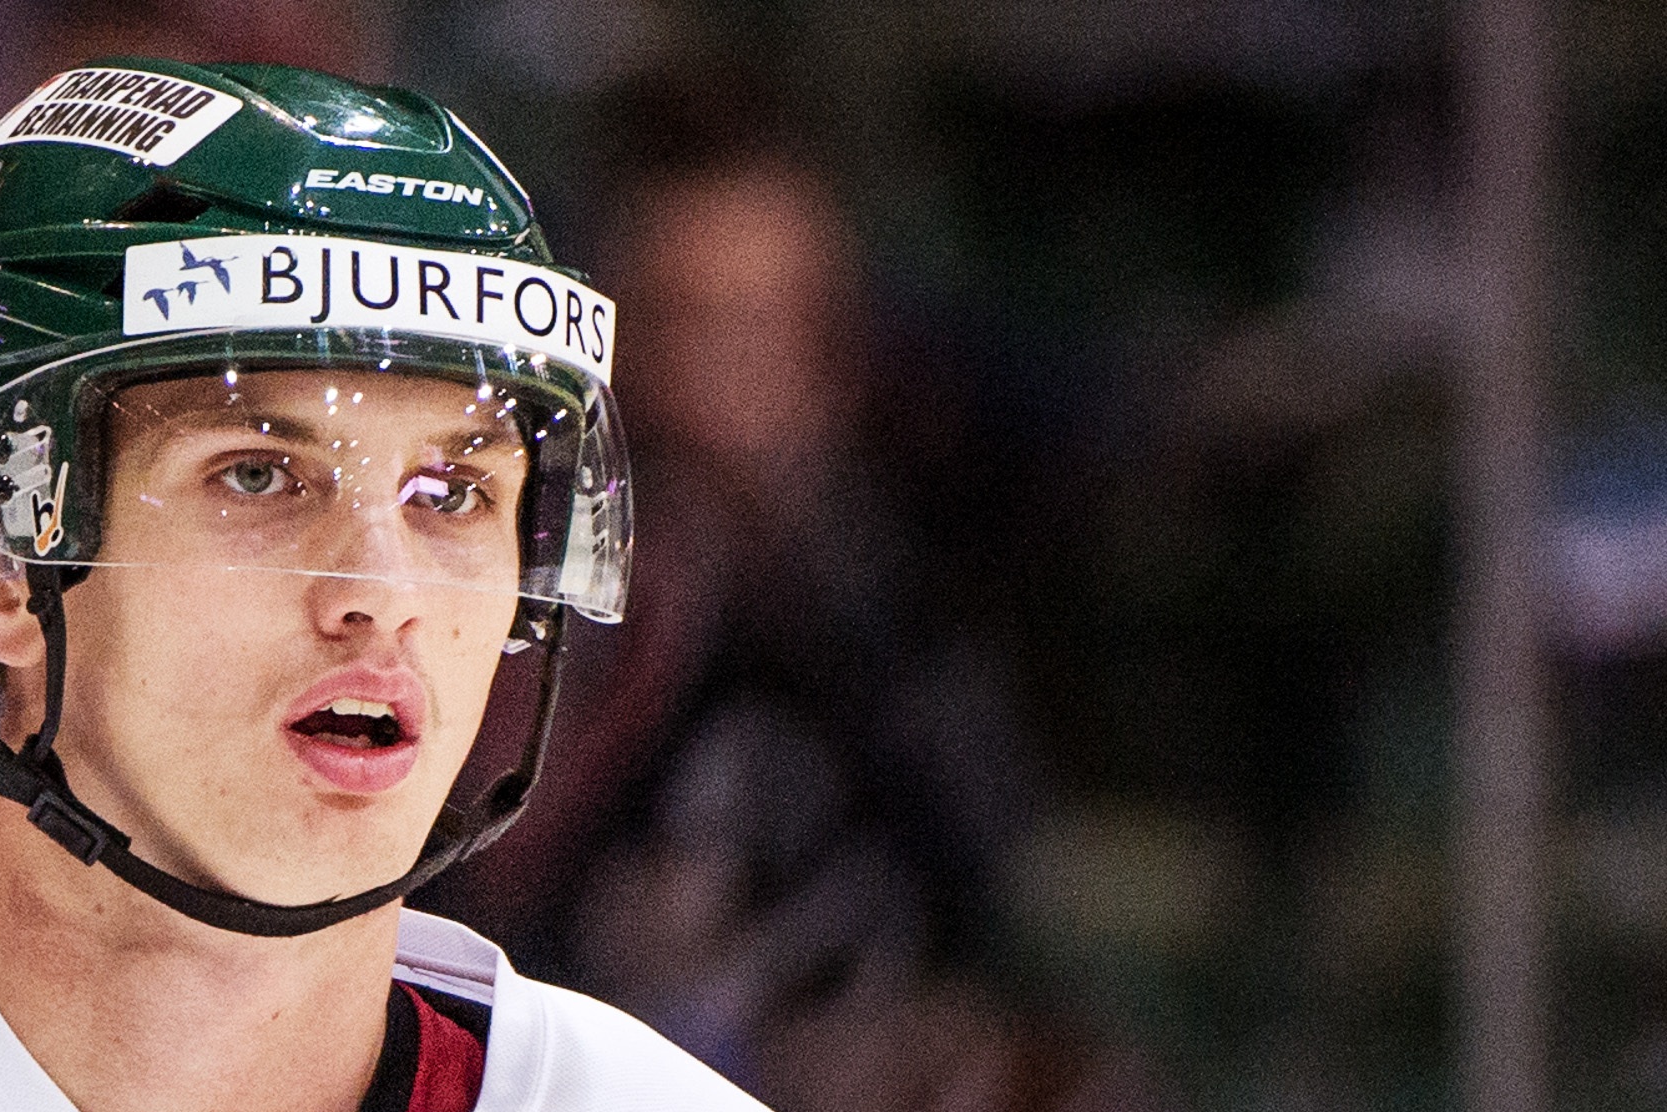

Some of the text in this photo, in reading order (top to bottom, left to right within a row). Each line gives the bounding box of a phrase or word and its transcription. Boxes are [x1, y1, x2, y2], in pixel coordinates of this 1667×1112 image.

[45, 71, 216, 119] TRANPENAD
[8, 102, 176, 153] BEMANNING
[305, 168, 483, 206] EASTON
[261, 245, 605, 363] BJURFORS
